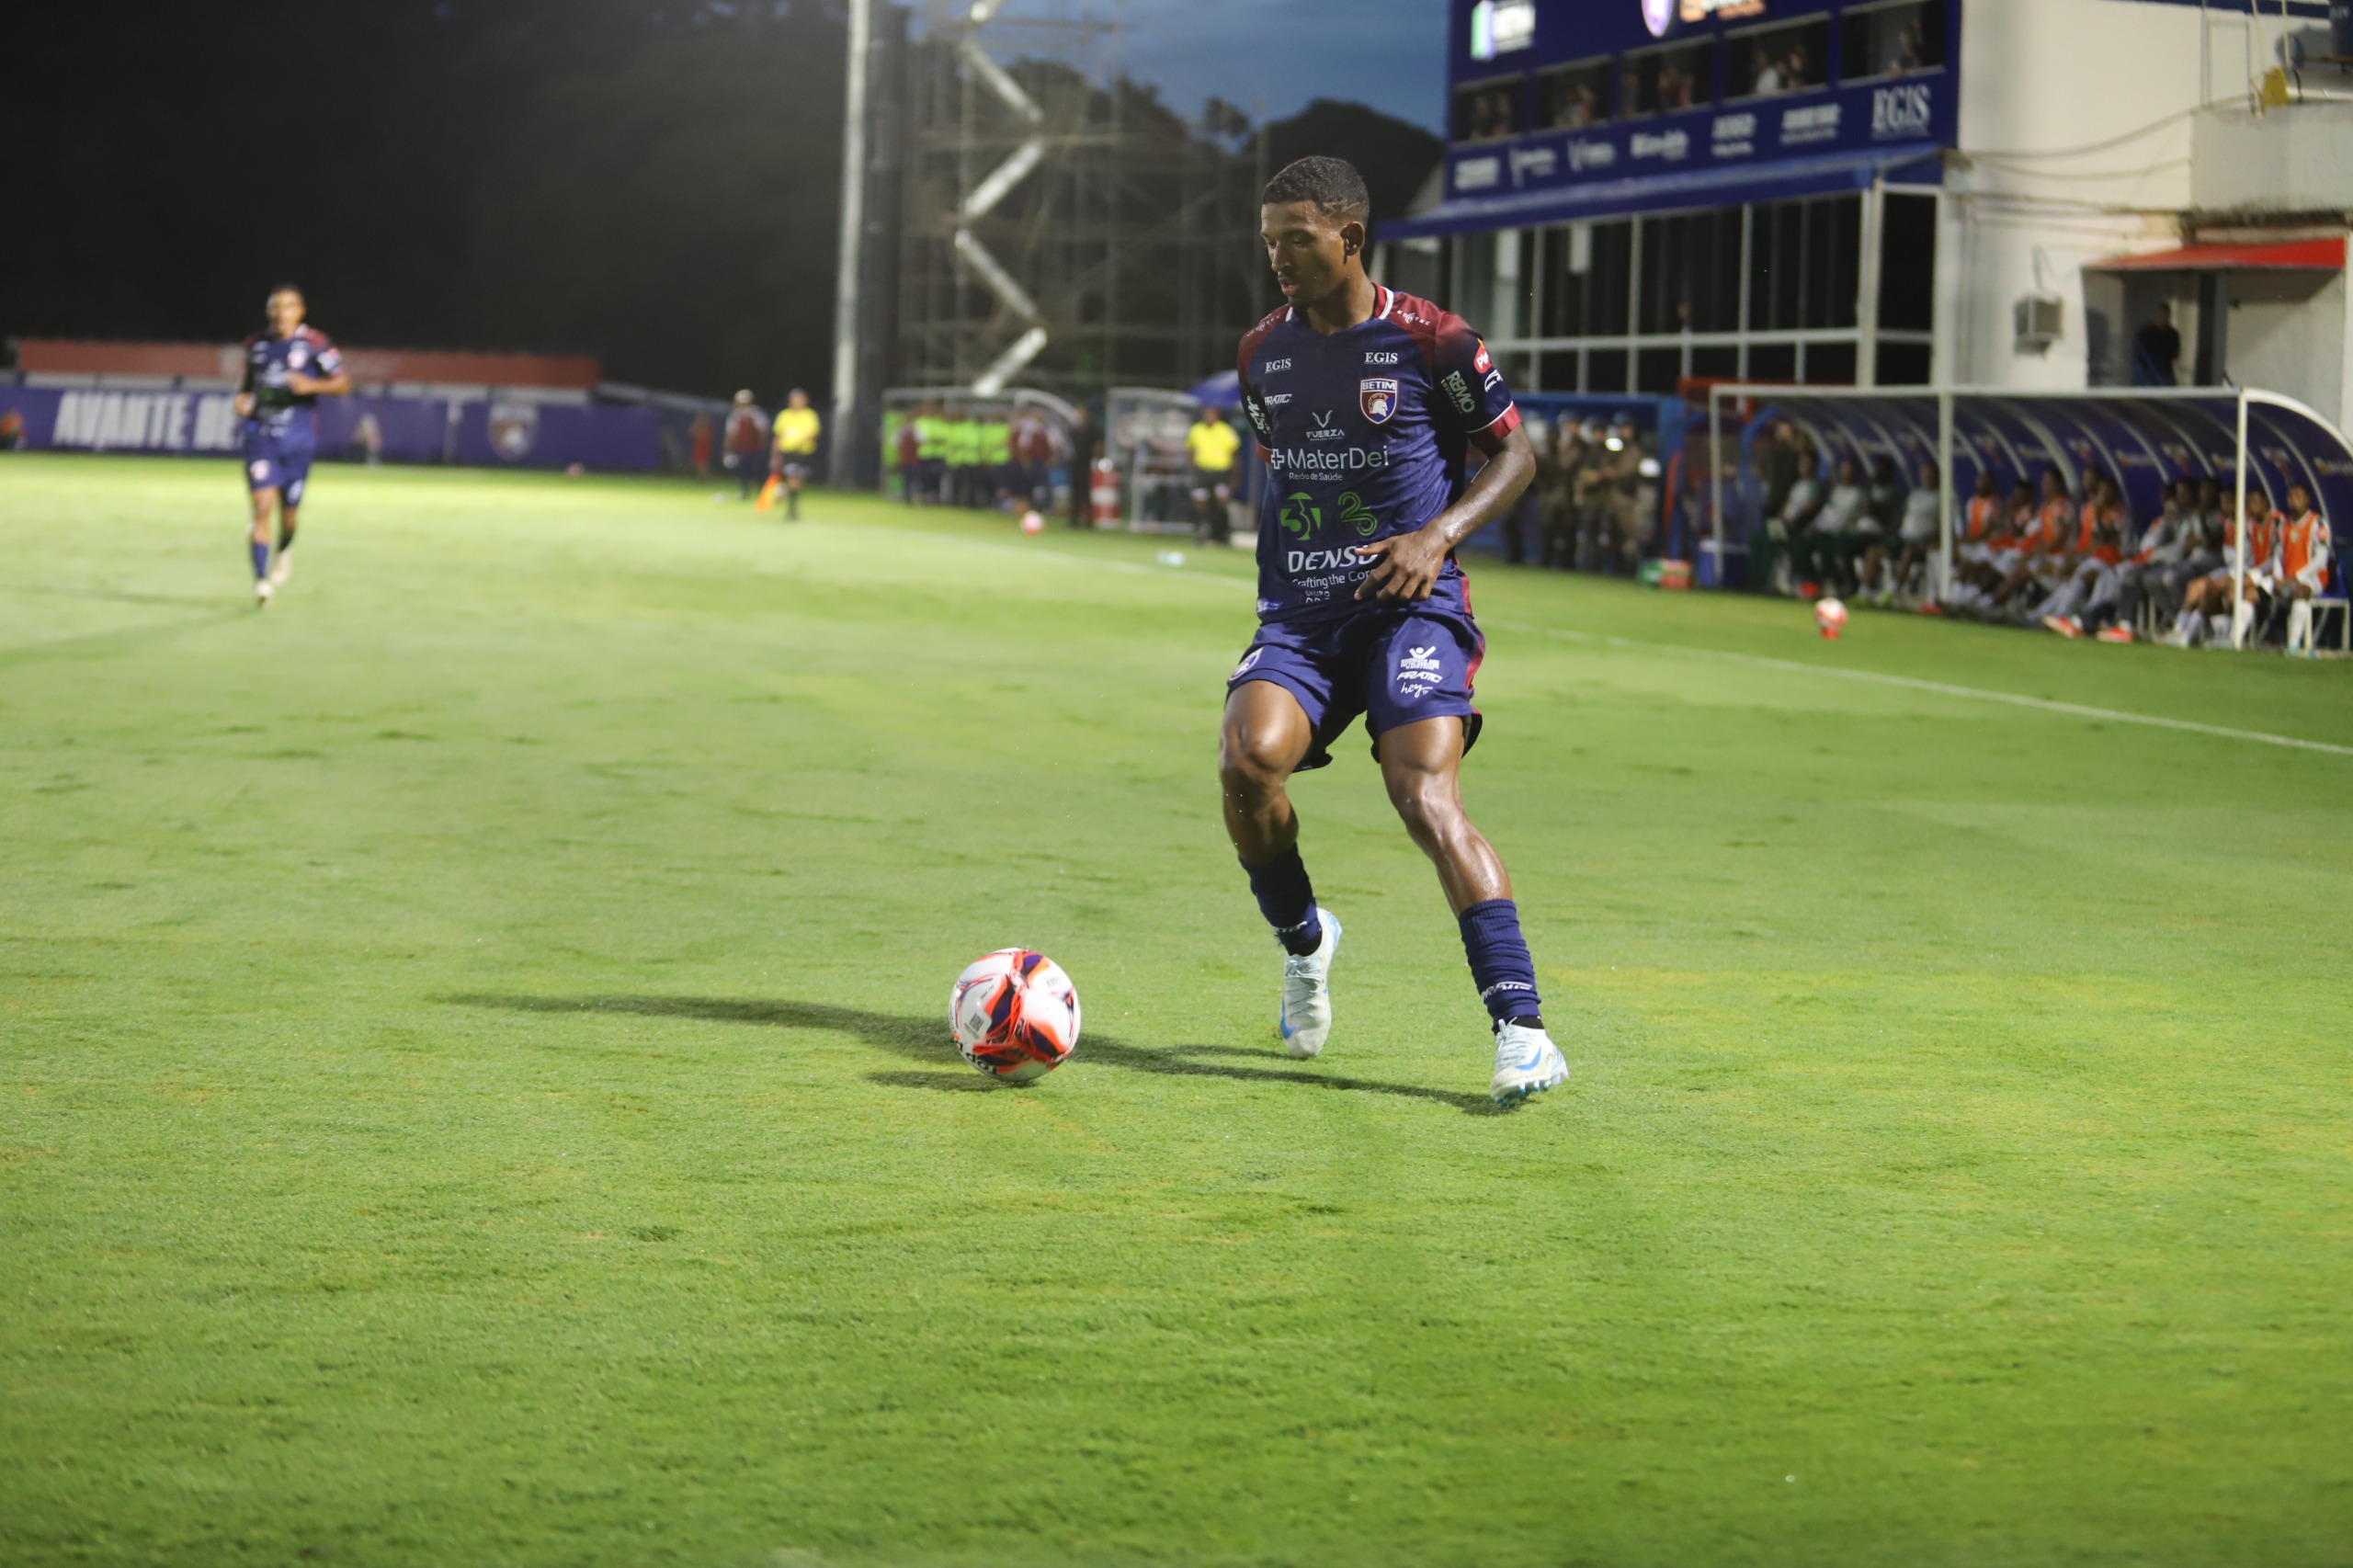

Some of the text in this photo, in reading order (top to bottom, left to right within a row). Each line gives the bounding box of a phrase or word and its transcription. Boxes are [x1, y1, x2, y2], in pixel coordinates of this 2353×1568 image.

[1364, 352, 1399, 363] EGIS
[1265, 358, 1291, 372] EGIS
[1362, 381, 1395, 391] BETIM
[52, 391, 191, 449] AVANTE
[1288, 445, 1389, 470] MaterDei
[1289, 472, 1344, 481] Rede de Saúde
[1328, 574, 1346, 585] the
